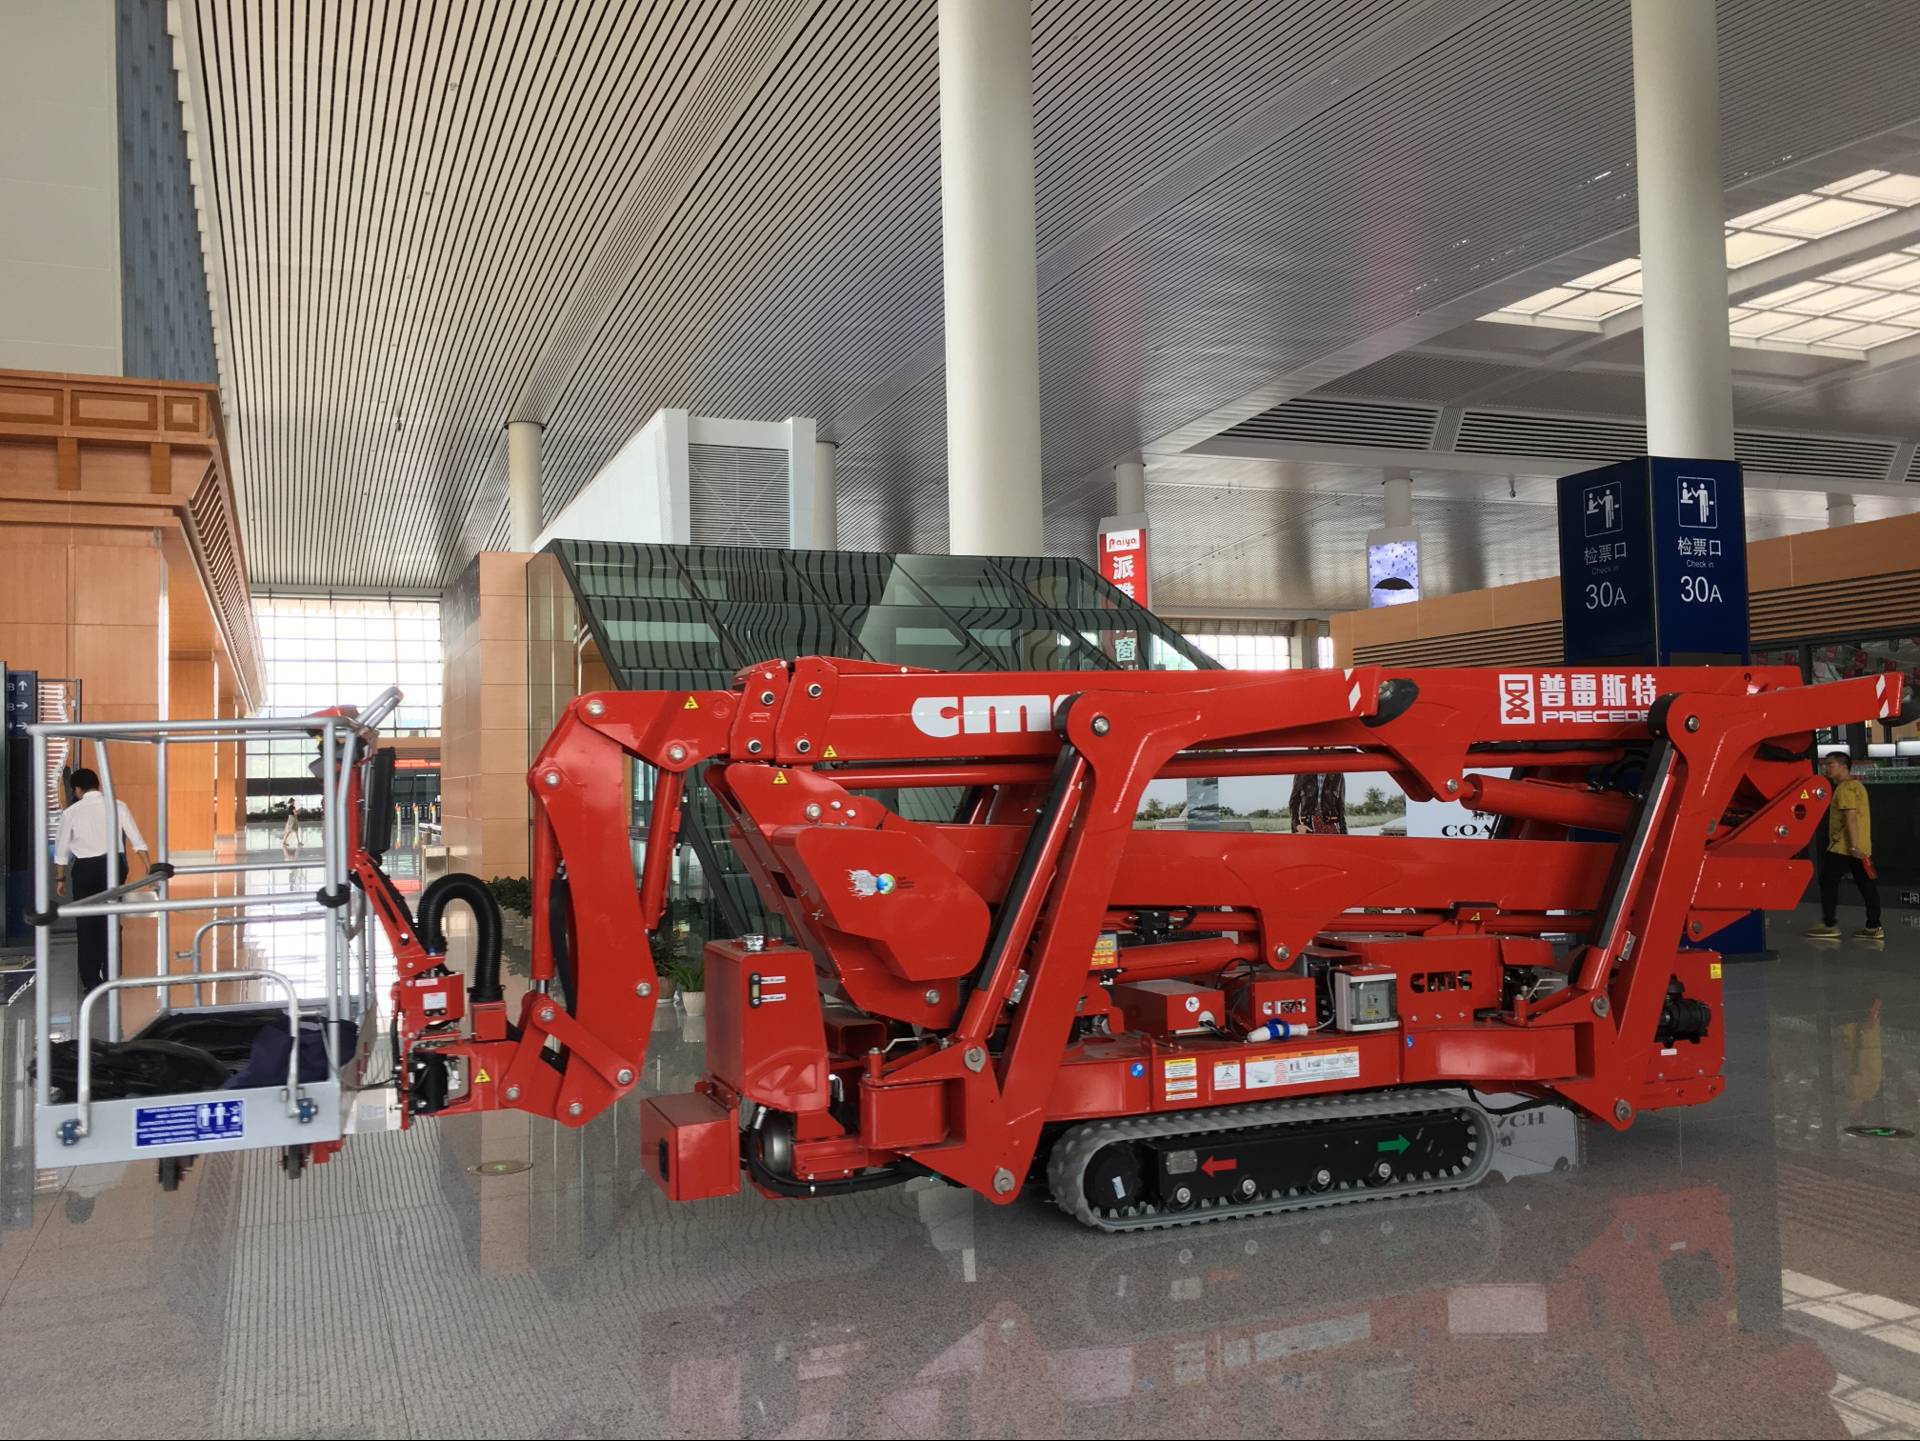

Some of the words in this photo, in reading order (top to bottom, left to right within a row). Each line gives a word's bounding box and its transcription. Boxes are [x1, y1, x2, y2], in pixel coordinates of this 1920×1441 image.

[1584, 542, 1627, 566] 检票口
[1677, 536, 1722, 557] 检票口
[1686, 559, 1706, 568] Check
[1585, 581, 1628, 610] 30A
[1680, 575, 1723, 603] 30A
[1540, 673, 1657, 707] 普雷斯特
[911, 694, 1071, 738] cm
